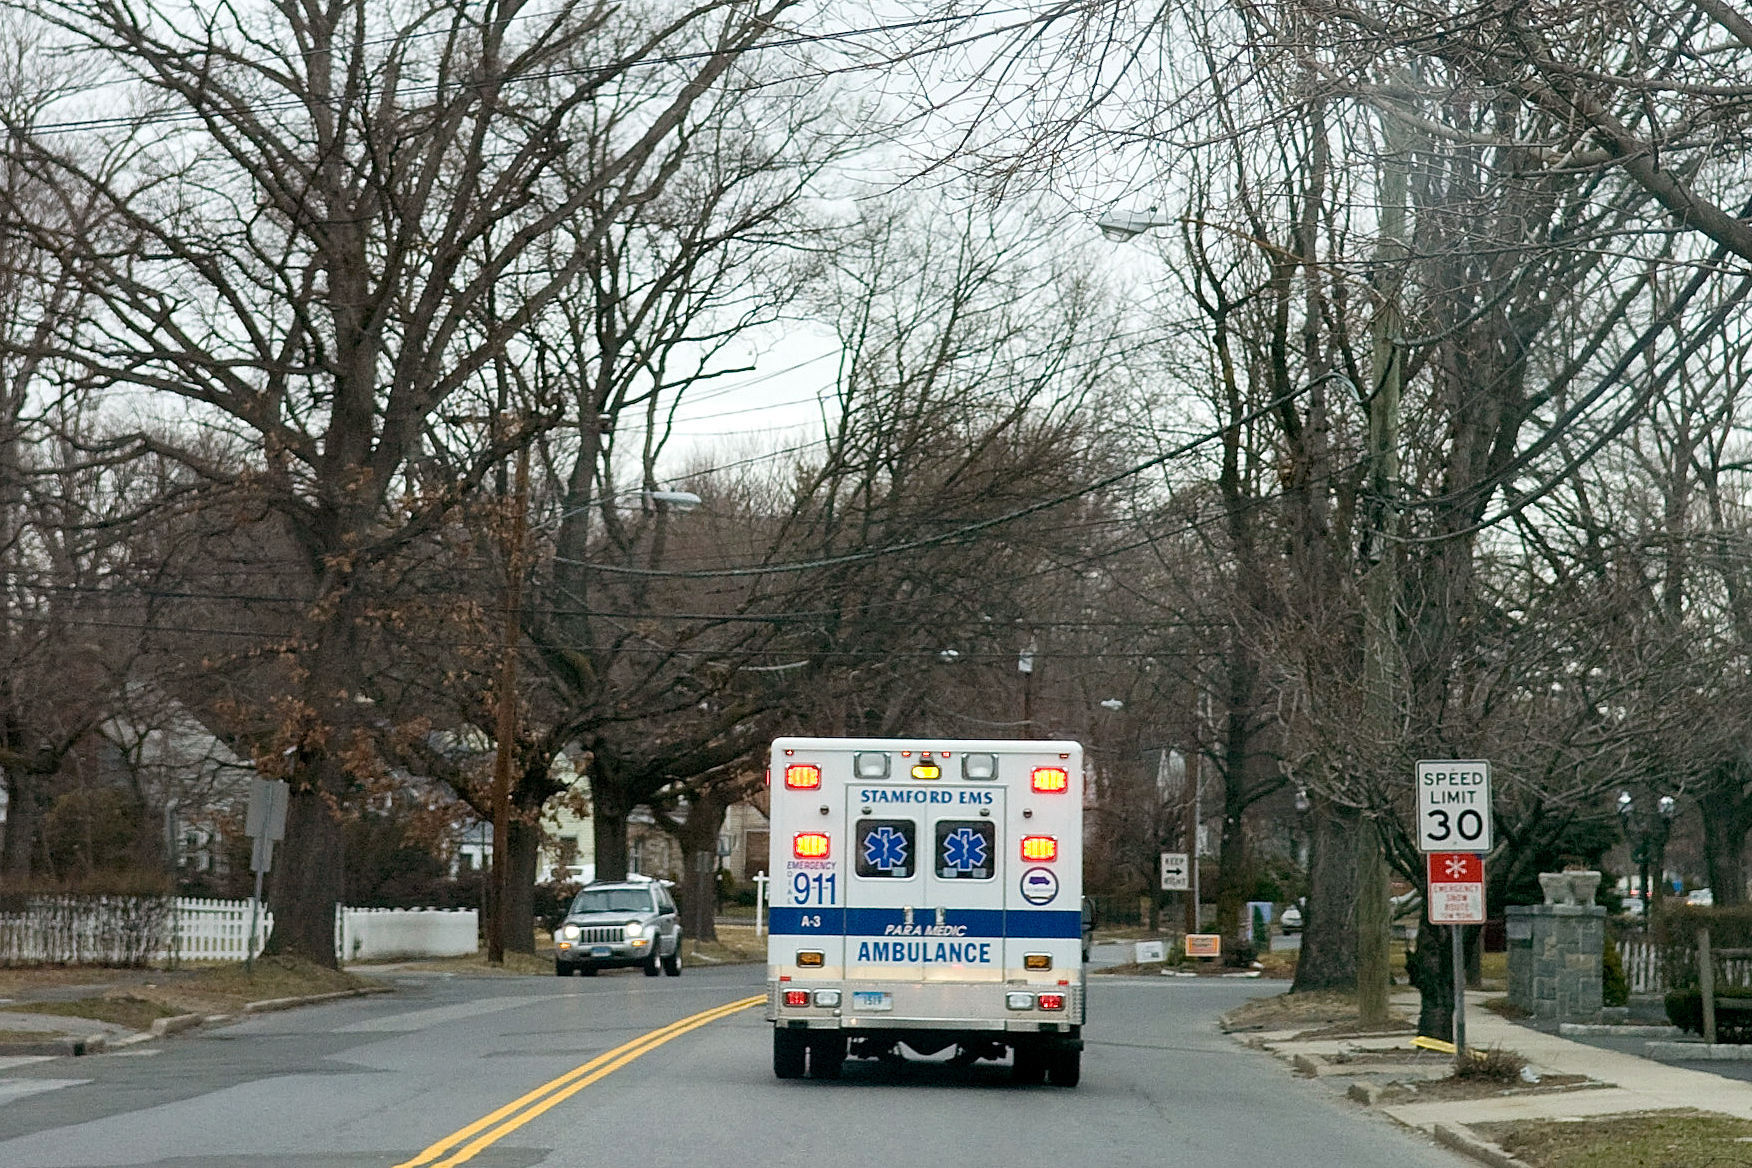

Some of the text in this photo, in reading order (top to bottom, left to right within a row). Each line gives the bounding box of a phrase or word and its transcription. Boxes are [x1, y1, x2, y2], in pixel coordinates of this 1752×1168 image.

[1424, 772, 1483, 786] SPEED
[861, 789, 993, 804] STAMFORD EMS
[1431, 790, 1477, 804] LIMIT
[1427, 809, 1483, 841] 30
[786, 861, 837, 870] EMERGENCY
[801, 915, 821, 928] A-3
[858, 941, 991, 963] AMBULANCE
